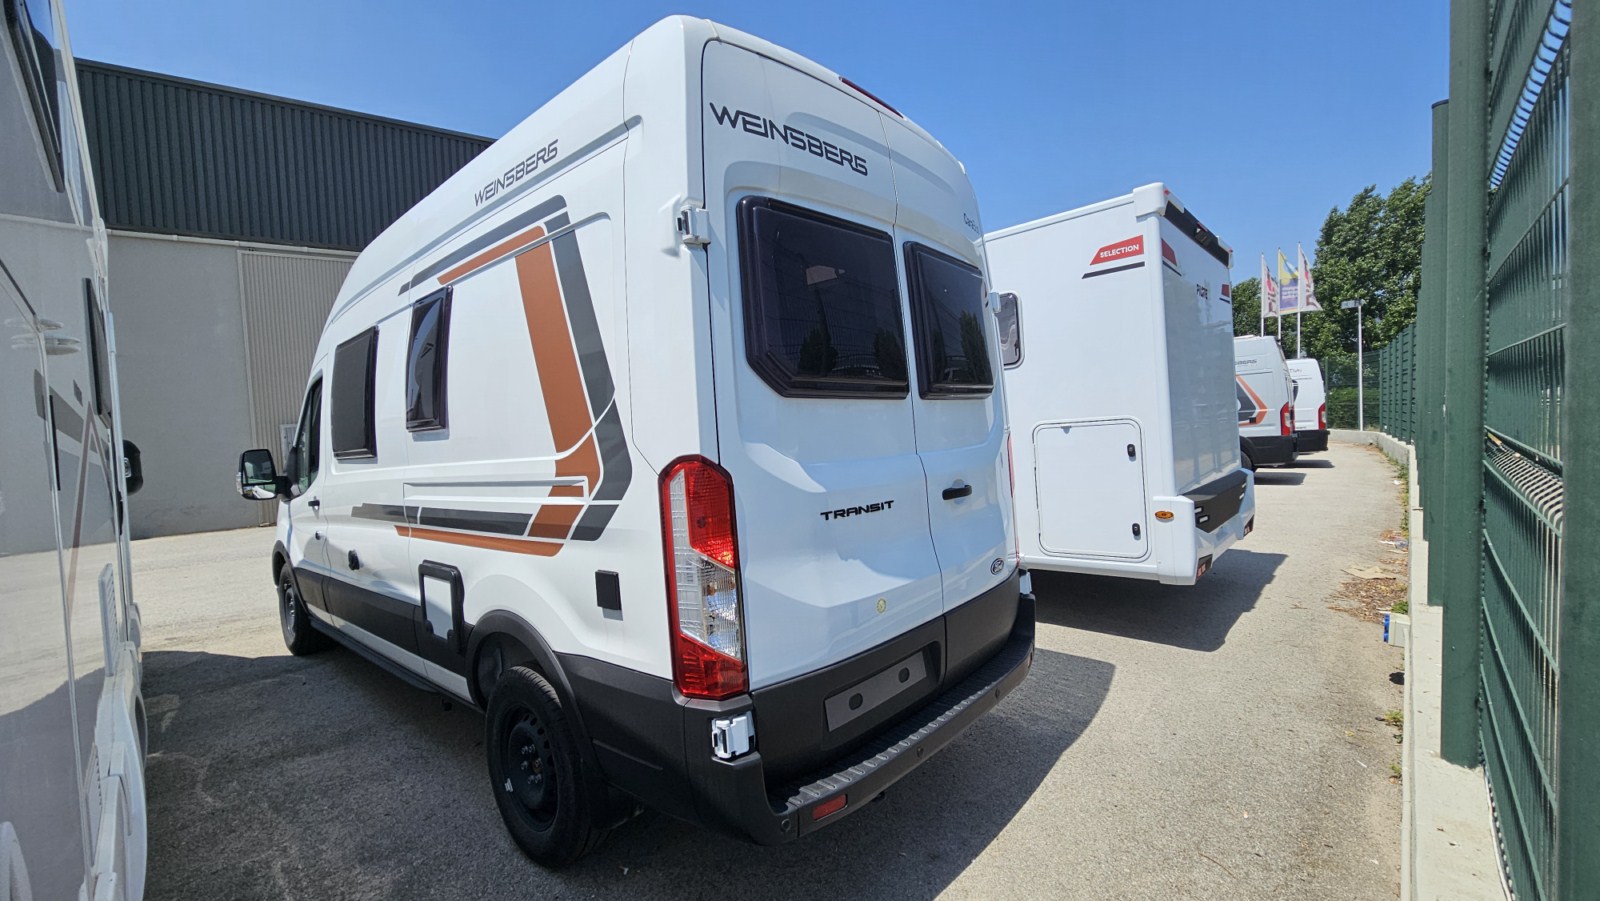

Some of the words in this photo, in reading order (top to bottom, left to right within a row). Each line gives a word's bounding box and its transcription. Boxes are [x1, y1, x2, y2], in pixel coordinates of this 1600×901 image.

[708, 102, 868, 177] WEINSBERG
[474, 138, 559, 207] WEINSBERG
[1100, 243, 1140, 258] SELECTION
[820, 499, 894, 521] TRANSIT
